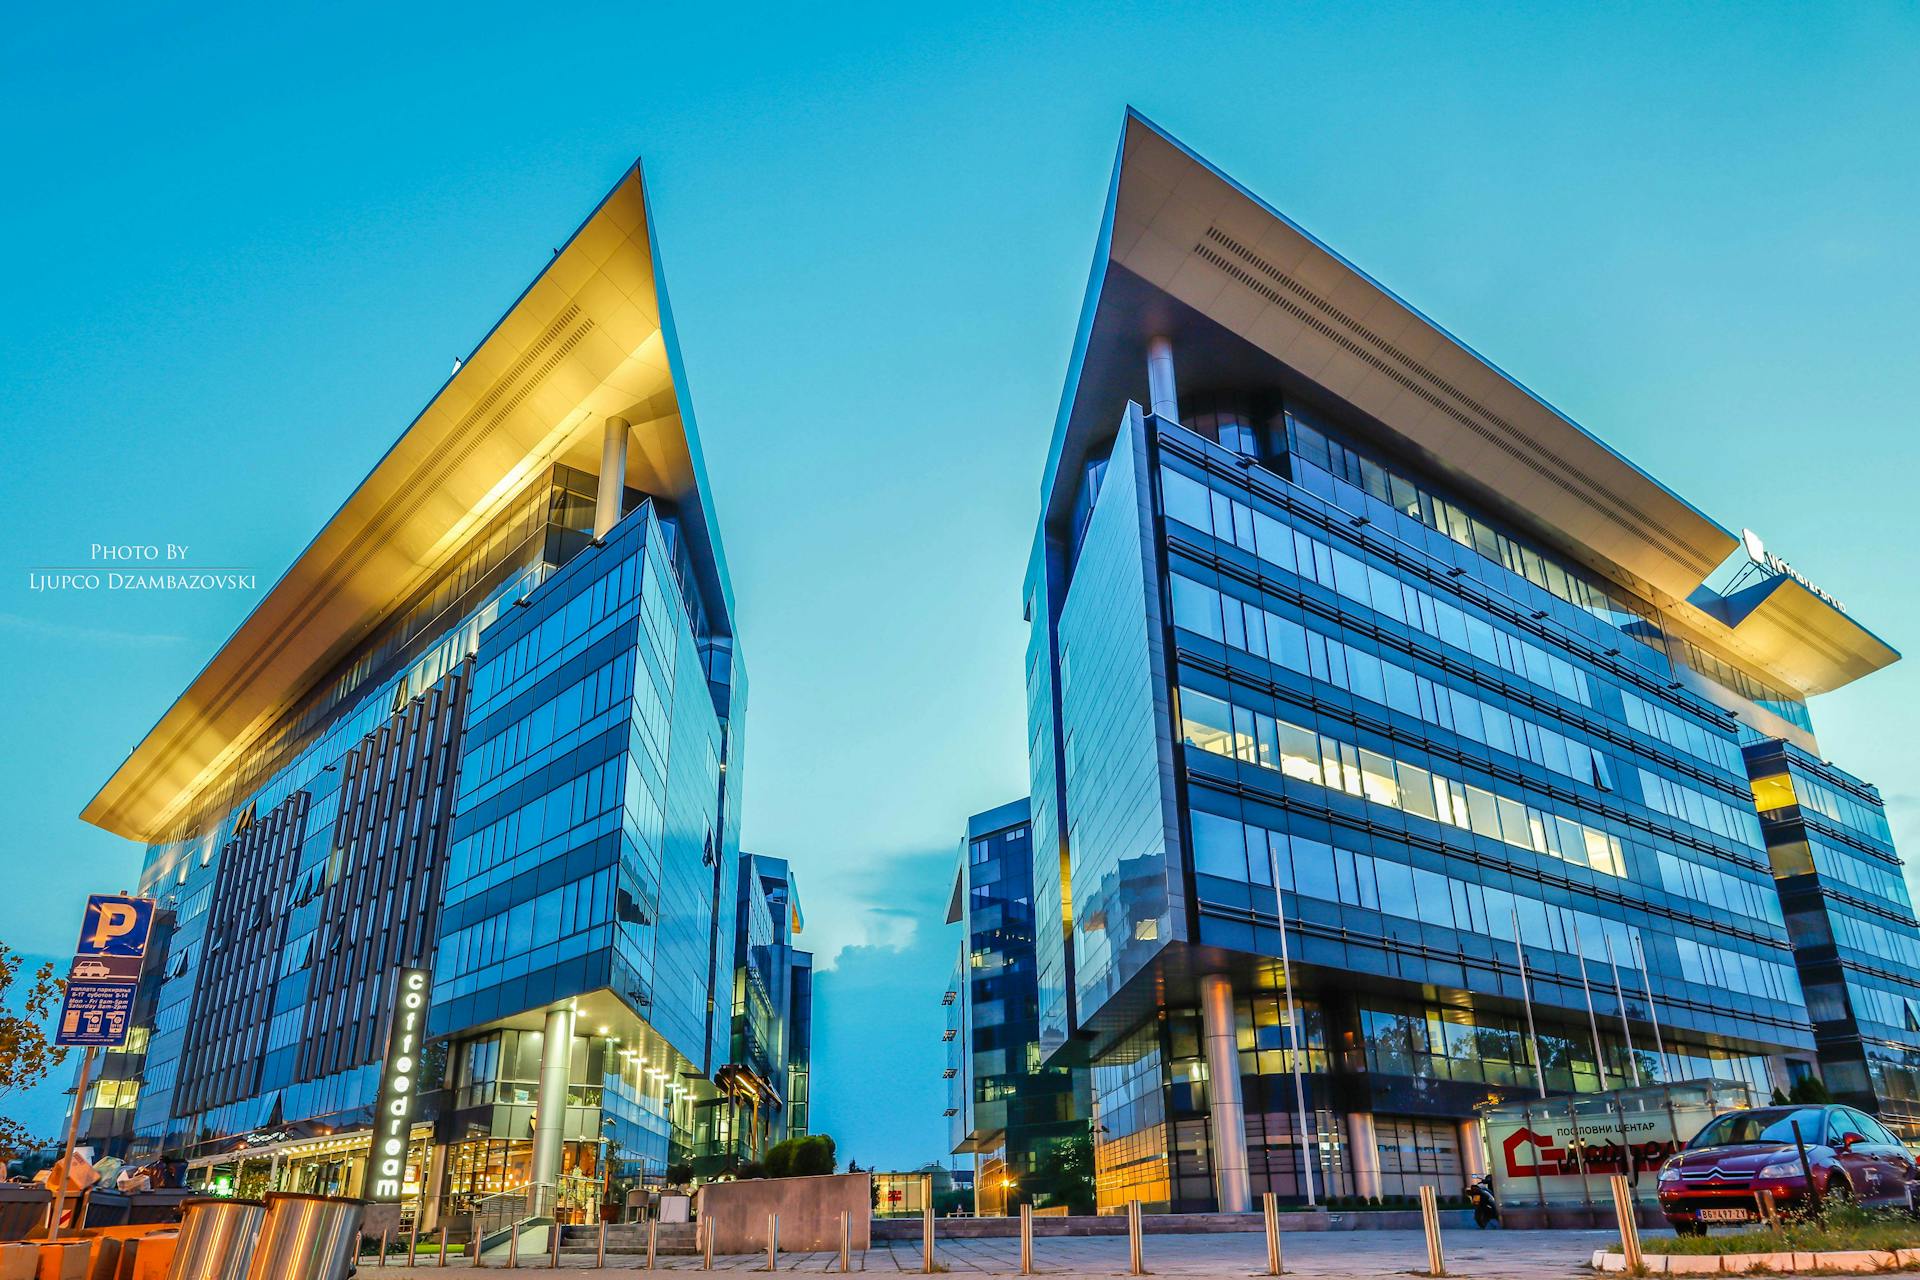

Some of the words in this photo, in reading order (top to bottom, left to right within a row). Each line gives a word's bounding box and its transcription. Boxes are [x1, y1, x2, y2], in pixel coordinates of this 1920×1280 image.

[93, 903, 137, 949] P
[376, 974, 424, 1197] coffeedream
[1557, 1125, 1613, 1137] ПОСЛОВНИ
[1614, 1122, 1655, 1134] ЦЕНТАР
